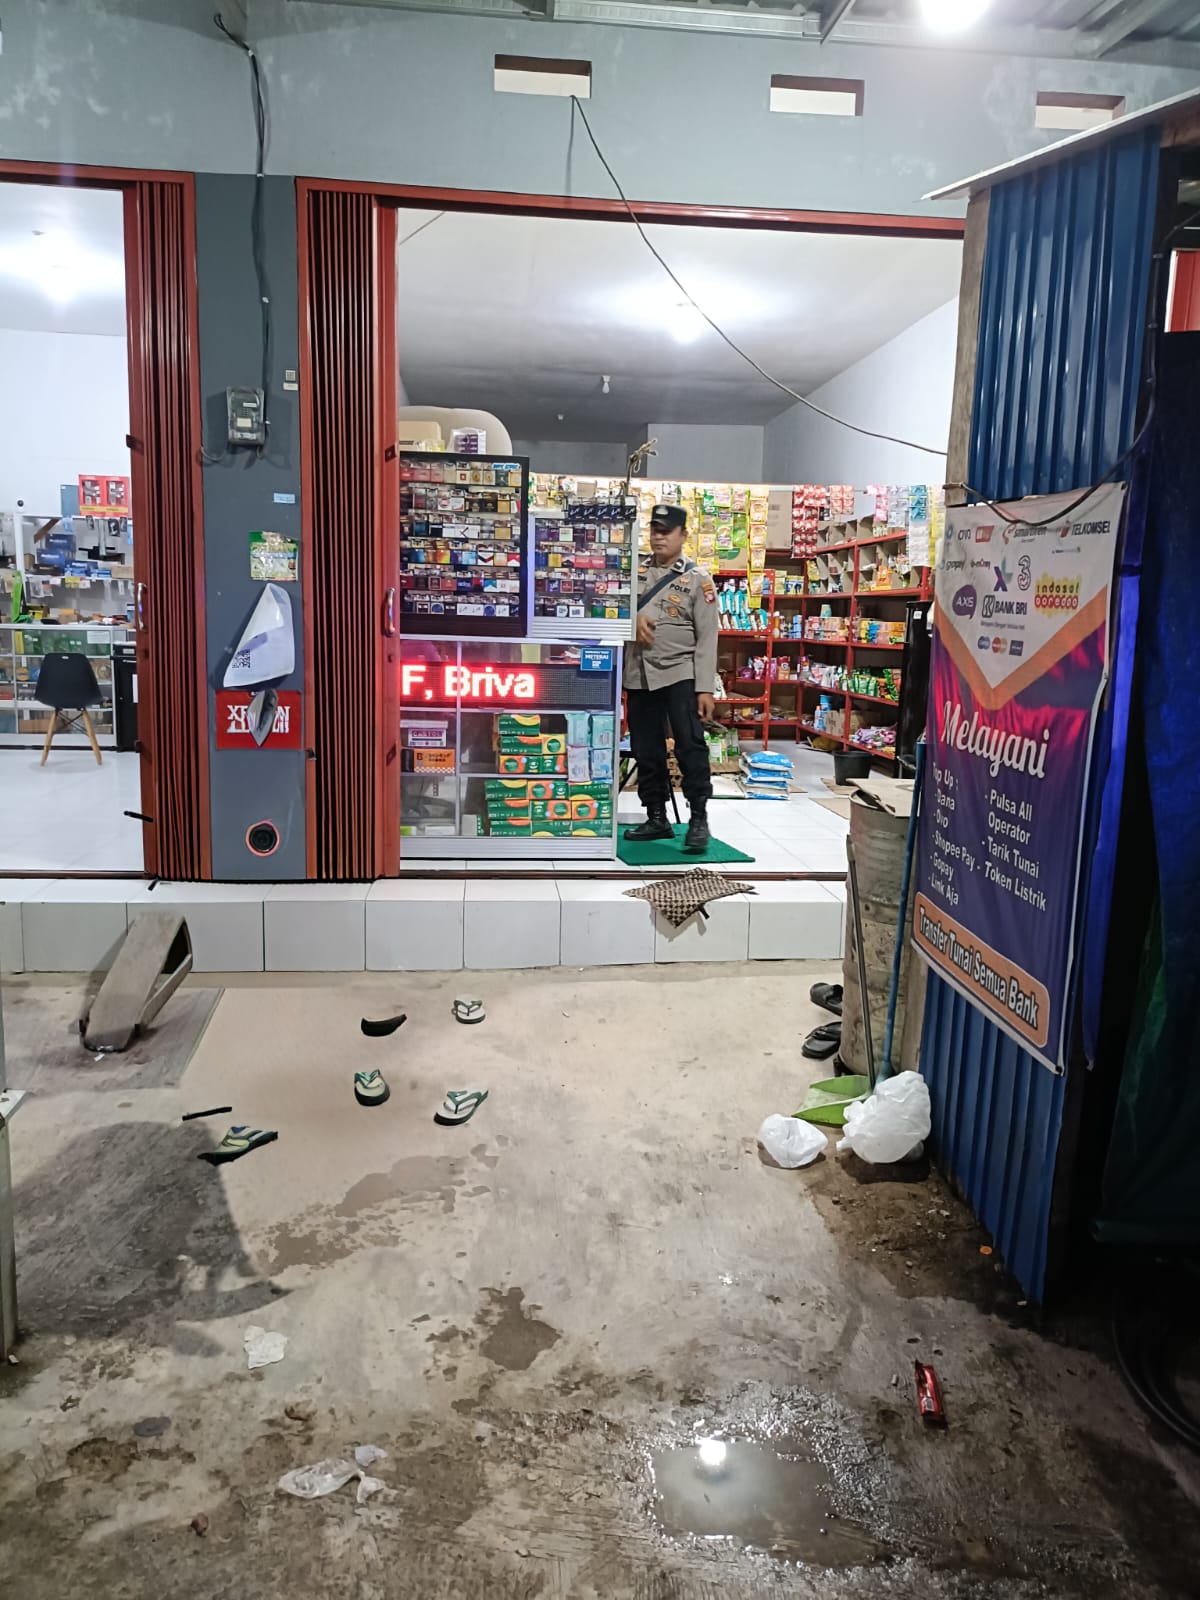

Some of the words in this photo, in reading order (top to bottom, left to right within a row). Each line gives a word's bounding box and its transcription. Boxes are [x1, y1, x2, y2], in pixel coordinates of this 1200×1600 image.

[1072, 521, 1110, 536] TELKOMSEL
[995, 601, 1014, 614] BANK
[1016, 602, 1027, 615] BRI
[402, 665, 433, 700] F,
[445, 665, 535, 698] Briva
[941, 700, 1047, 778] Melayani
[944, 769, 954, 790] Up
[937, 788, 955, 810] Dana
[990, 788, 1017, 815] Pulsa
[1018, 801, 1032, 822] All
[988, 811, 1031, 845] Operator
[933, 851, 954, 881] Gopay
[935, 830, 960, 859] Shopee
[961, 846, 975, 872] Pay
[987, 835, 1010, 863] Tarik
[1013, 848, 1040, 879] Tunai
[931, 872, 945, 895] Link
[946, 884, 959, 906] Aja
[984, 860, 1012, 892] Token
[1014, 877, 1047, 912] Listrik
[919, 906, 948, 954] Transfer
[948, 931, 973, 976] Tunai
[973, 952, 1007, 1004] Semua
[1007, 976, 1039, 1030] Bank
